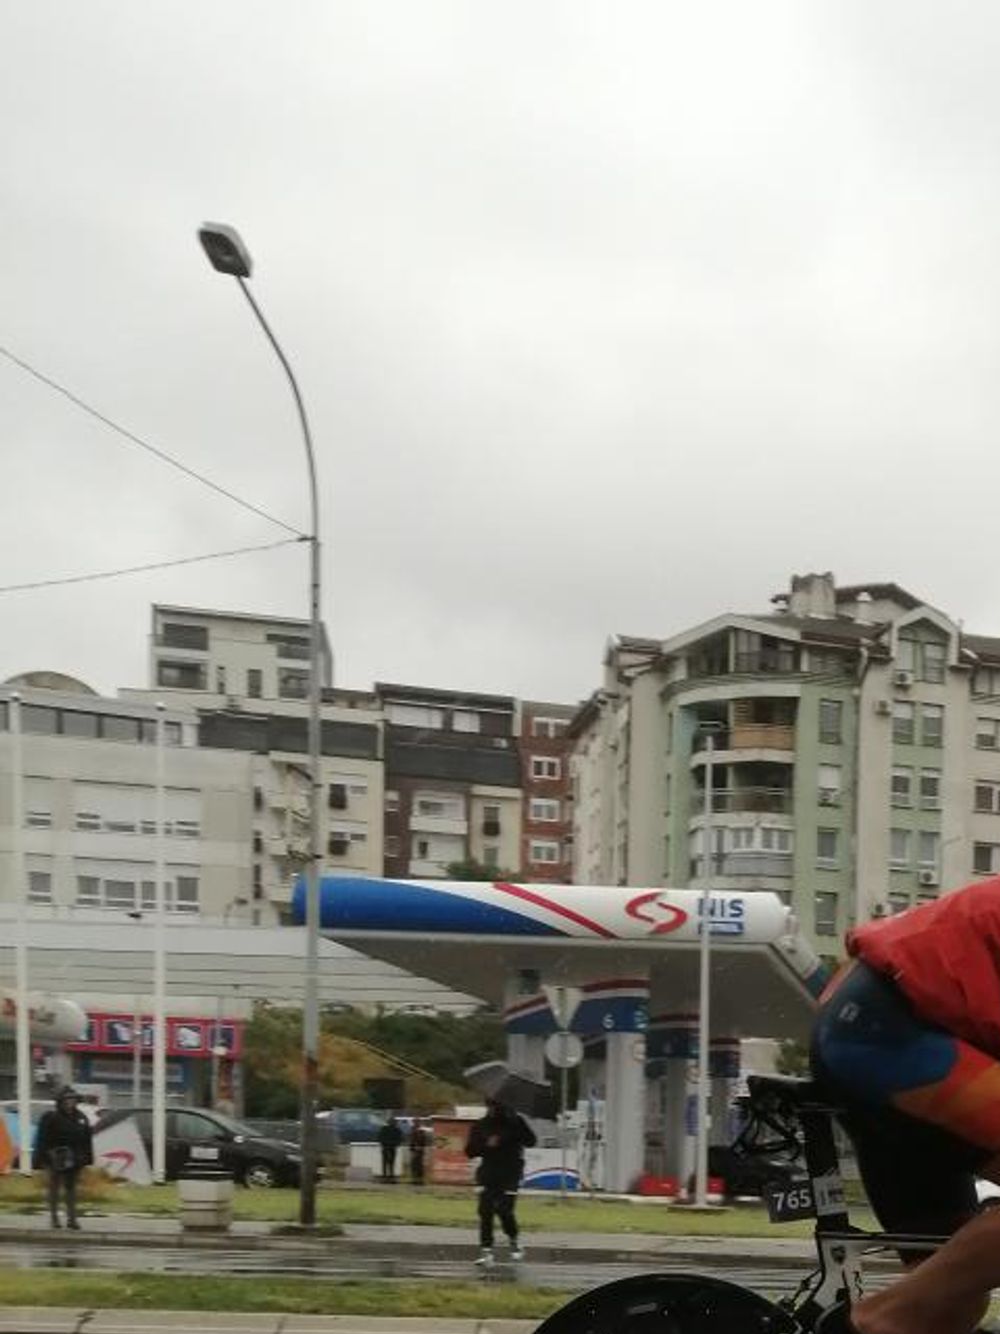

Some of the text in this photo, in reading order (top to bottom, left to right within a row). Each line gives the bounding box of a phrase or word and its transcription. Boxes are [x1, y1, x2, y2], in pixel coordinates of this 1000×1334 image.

[697, 898, 744, 918] NIS
[602, 1013, 614, 1029] 6
[771, 1188, 813, 1212] 765
